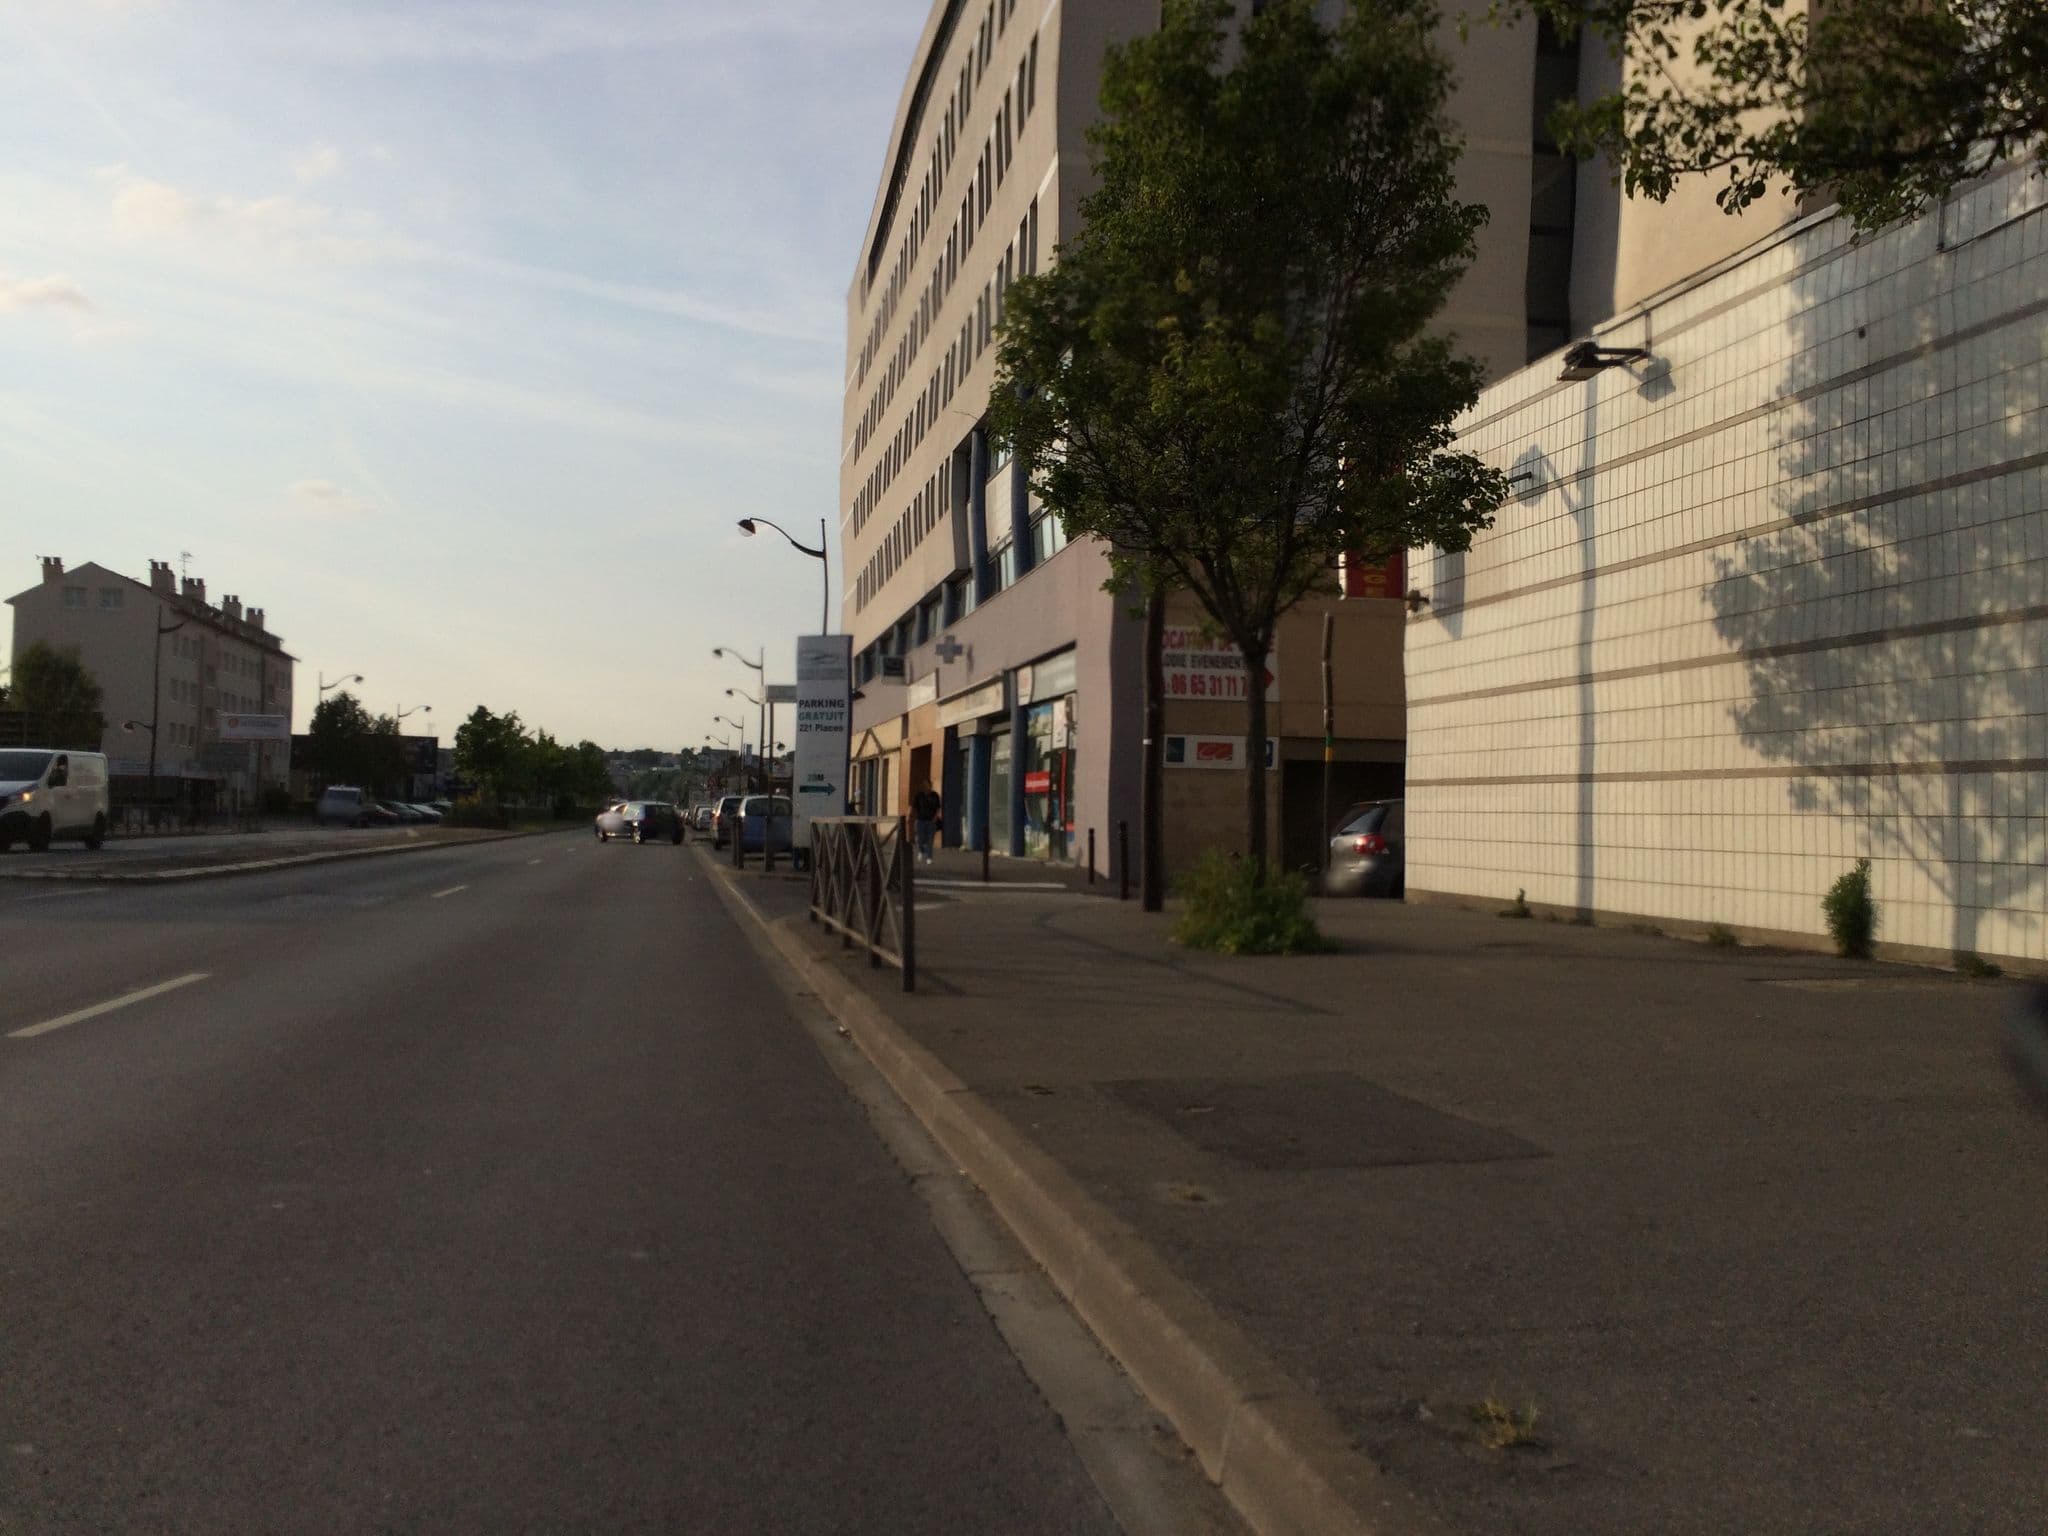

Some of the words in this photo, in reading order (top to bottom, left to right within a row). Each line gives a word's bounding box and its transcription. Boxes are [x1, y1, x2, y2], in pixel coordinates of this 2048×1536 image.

[1190, 673, 1206, 695] 65
[799, 699, 845, 709] PARKING
[799, 711, 845, 721] GRATUIT
[800, 723, 812, 732] 221
[815, 723, 844, 732] Places
